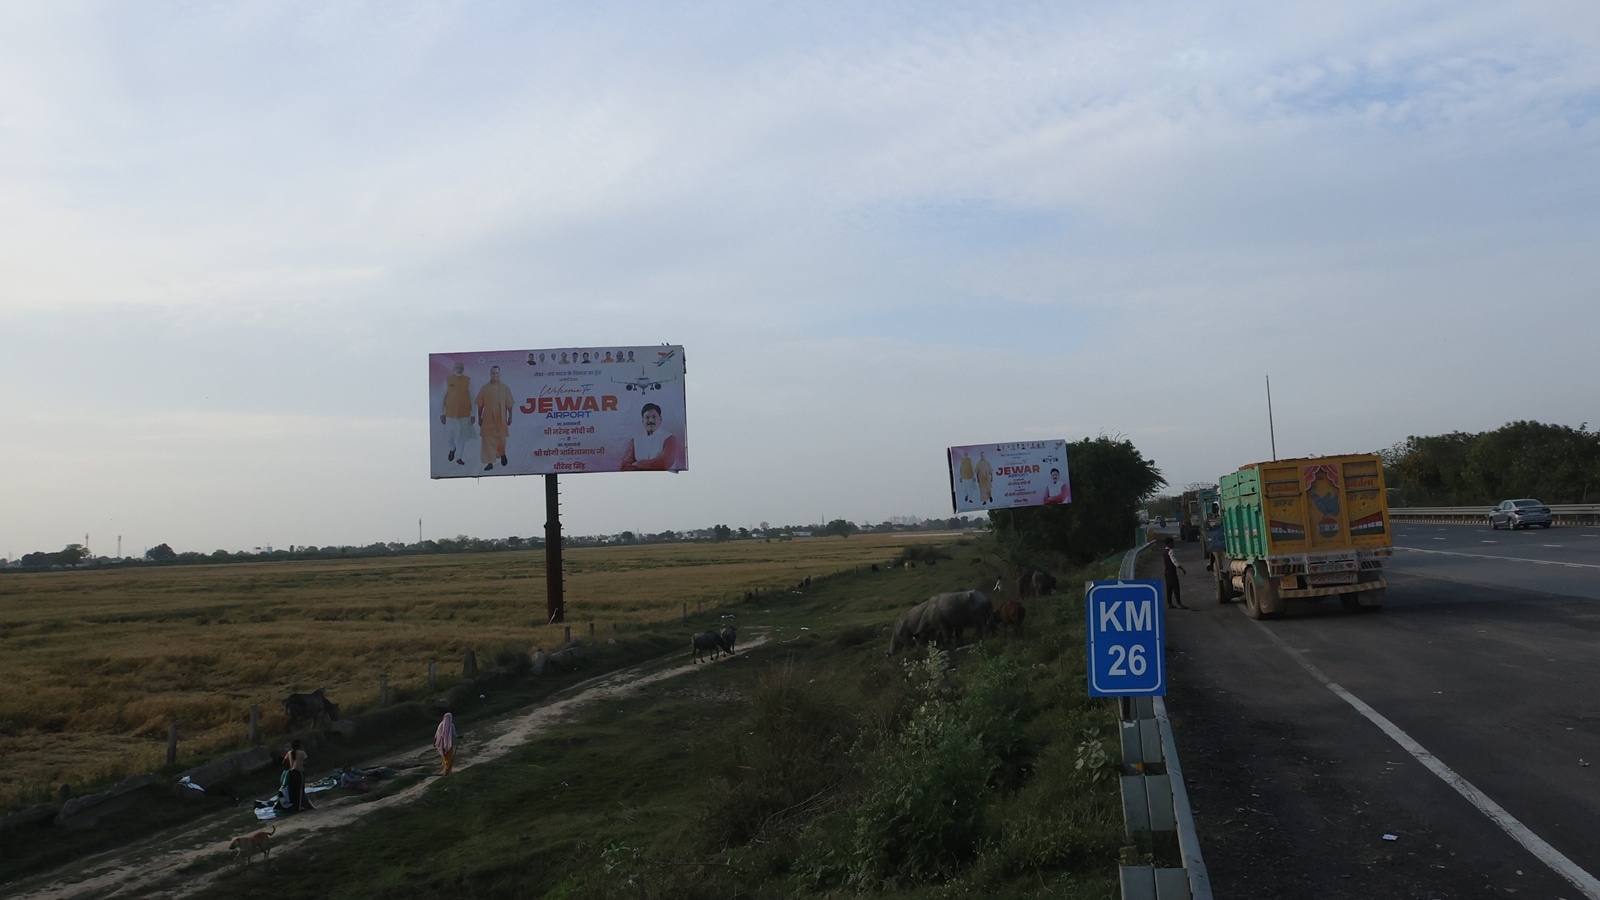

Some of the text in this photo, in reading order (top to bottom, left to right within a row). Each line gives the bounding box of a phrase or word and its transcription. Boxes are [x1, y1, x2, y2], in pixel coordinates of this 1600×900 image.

[539, 384, 581, 397] Welcome
[520, 395, 618, 414] JEWAR
[546, 411, 592, 419] AIRPORT
[553, 427, 570, 435] नरेन्द्र
[571, 426, 585, 434] मोदी
[586, 425, 595, 434] जी
[534, 447, 605, 457] श्री योगी आदित्यनाथ जी
[996, 464, 1040, 476] JEWAR
[1099, 600, 1152, 632] KM
[1108, 644, 1147, 676] 26
